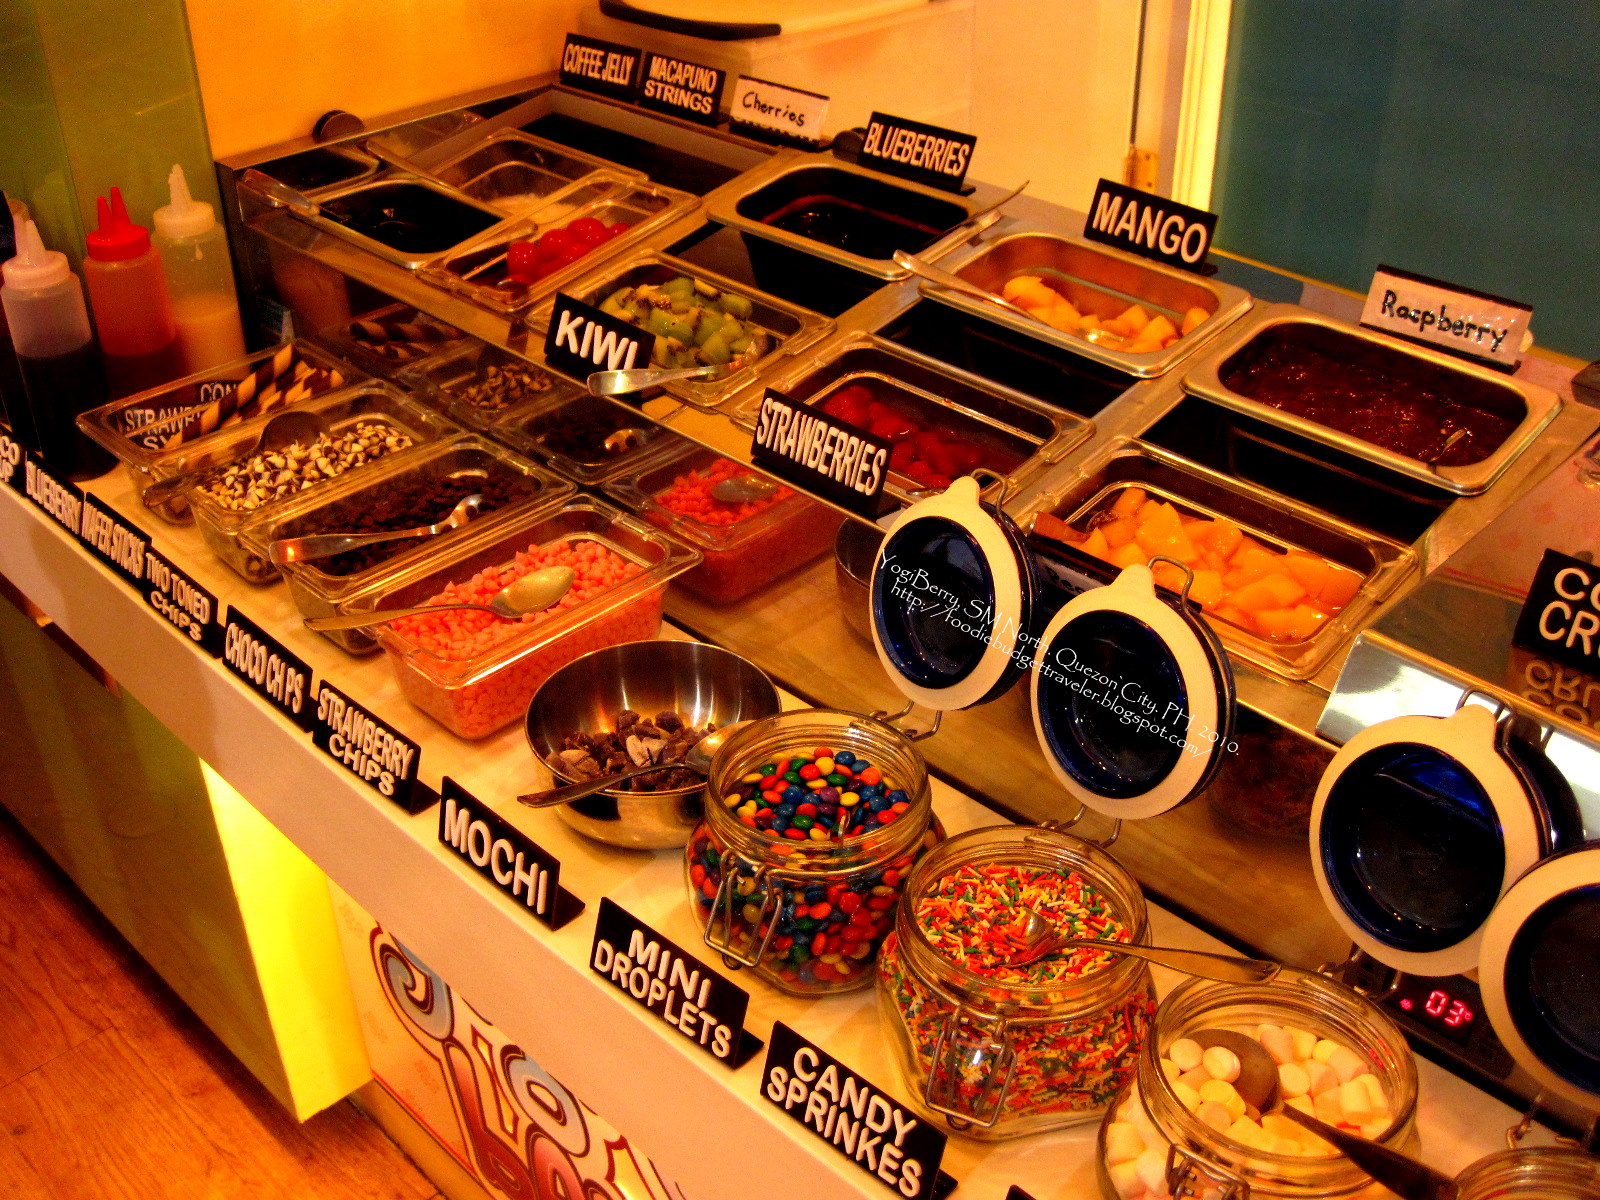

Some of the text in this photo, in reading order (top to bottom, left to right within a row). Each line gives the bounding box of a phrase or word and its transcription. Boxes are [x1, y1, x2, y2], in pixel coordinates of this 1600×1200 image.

[563, 43, 635, 86] COFFEE JELLY
[644, 80, 713, 115] STRINGS
[649, 56, 718, 94] MACAPUNO
[742, 92, 805, 127] Cherries
[863, 122, 970, 176] BLUEBERRIES
[1092, 192, 1208, 263] MANGO
[555, 310, 638, 371] KIWI
[757, 398, 886, 496] STRAWBERRIES
[146, 552, 211, 624] TWO TONED
[151, 590, 202, 641] CHIPS
[225, 623, 268, 685] CHOCO
[317, 688, 414, 780] STRAWBERRY
[329, 733, 395, 796] CHIPS
[445, 799, 548, 914] MOCHI
[594, 939, 732, 1058] DROPLETS
[628, 929, 711, 1008] MINI
[793, 1047, 918, 1147] CANDY
[766, 1066, 921, 1198] SPRINKES
